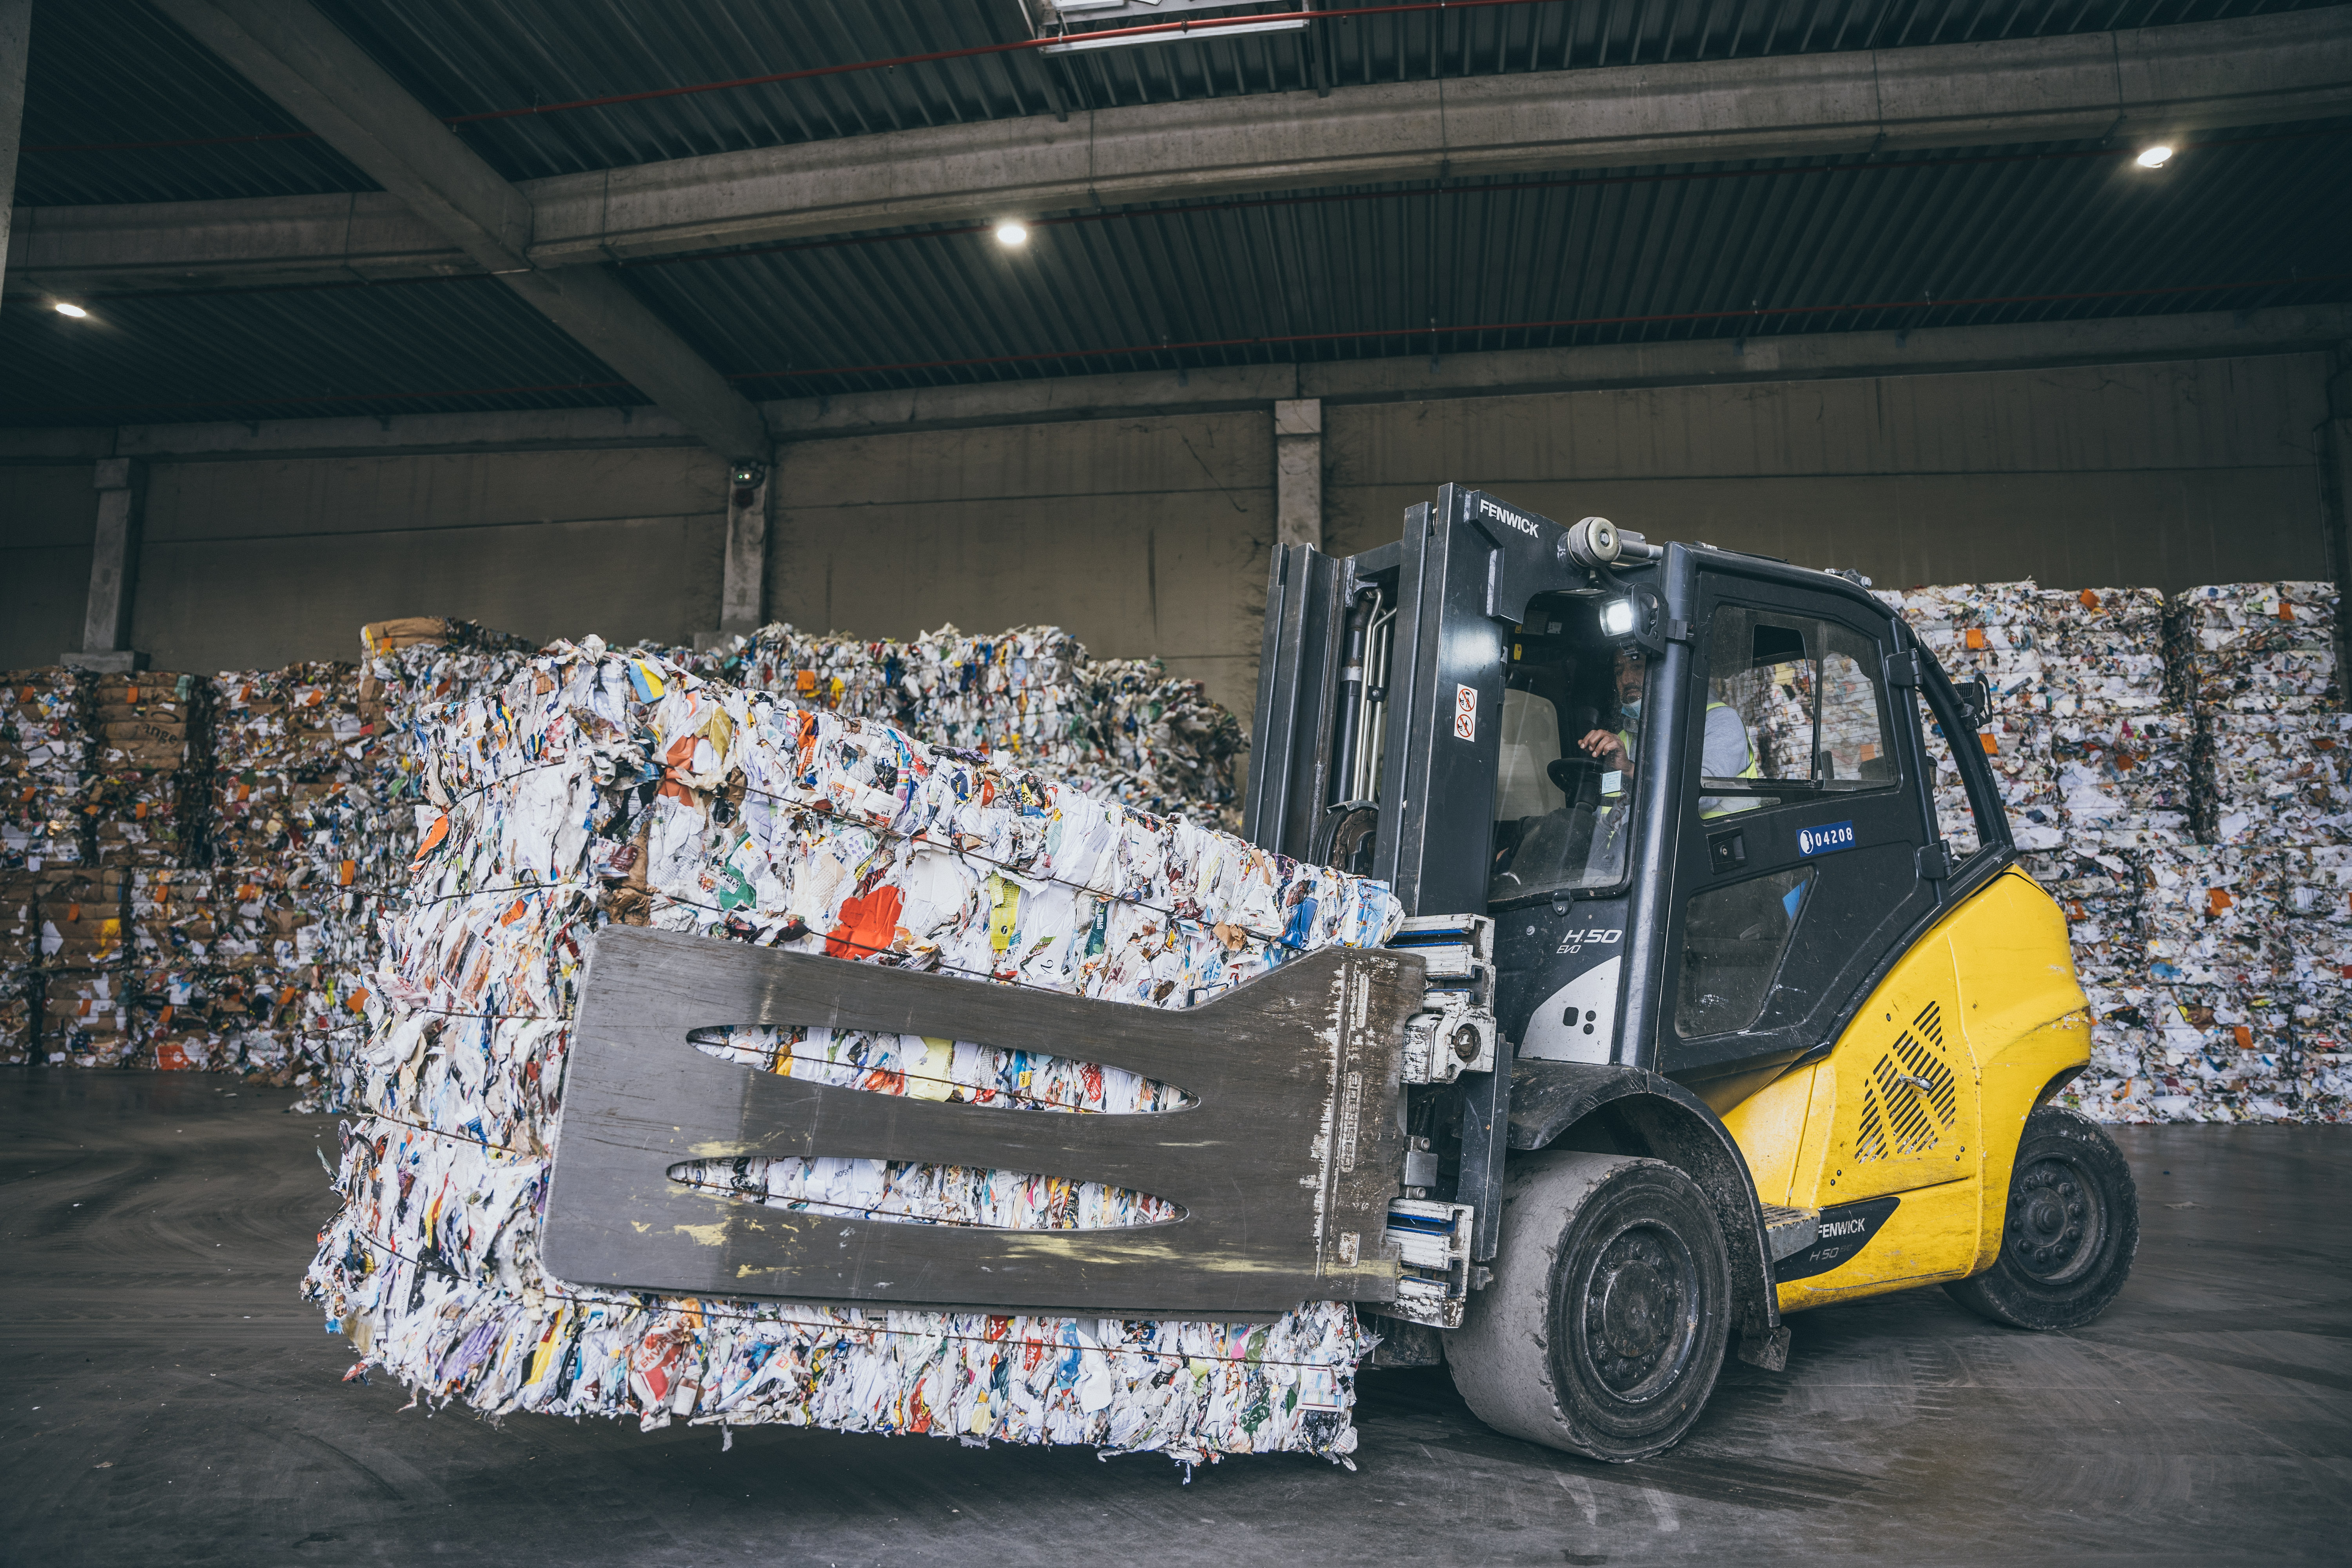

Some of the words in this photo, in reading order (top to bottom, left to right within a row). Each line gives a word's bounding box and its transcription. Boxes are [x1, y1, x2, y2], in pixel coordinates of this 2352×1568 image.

[1480, 499, 1539, 538] FENWICK
[1815, 827, 1853, 846] 04208
[1556, 945, 1581, 954] EVO
